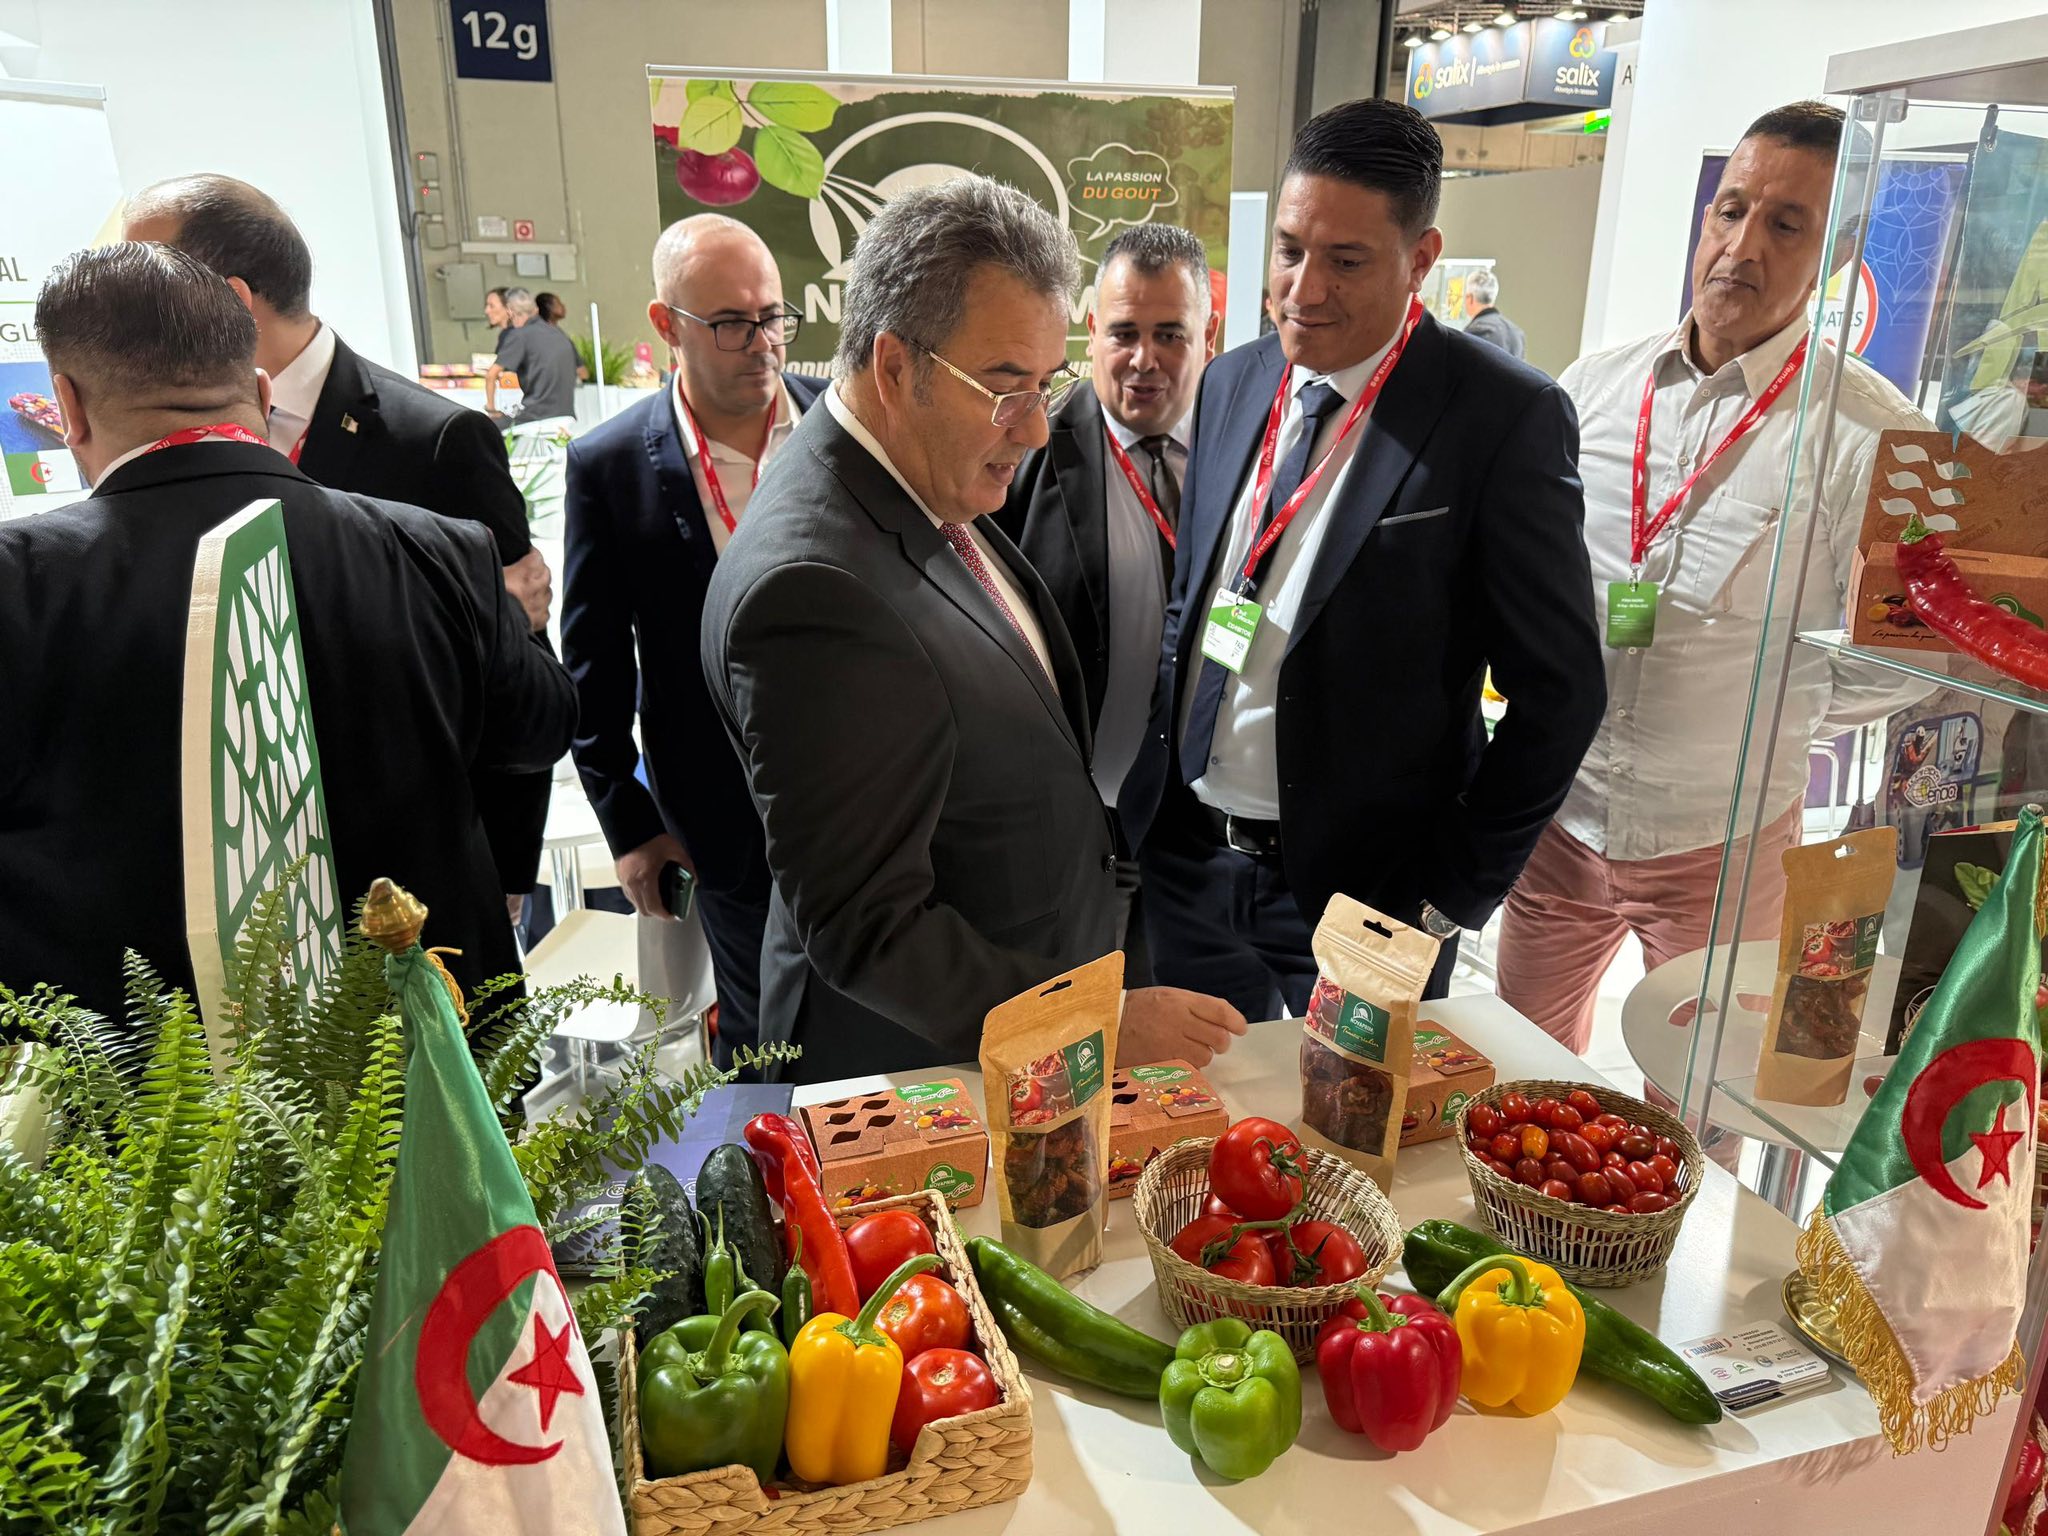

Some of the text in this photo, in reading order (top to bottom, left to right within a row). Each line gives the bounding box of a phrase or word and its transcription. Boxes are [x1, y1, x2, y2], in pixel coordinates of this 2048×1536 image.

[462, 11, 538, 60] 12g
[1434, 57, 1471, 89] salix
[1555, 62, 1600, 87] salix
[1086, 171, 1162, 183] LA PASSION
[1082, 186, 1162, 201] DU GOUT
[1814, 310, 1864, 328] ATS
[1370, 350, 1398, 387] ifema.es
[1769, 361, 1797, 394] ifema.es
[1255, 522, 1282, 557] ifema.es
